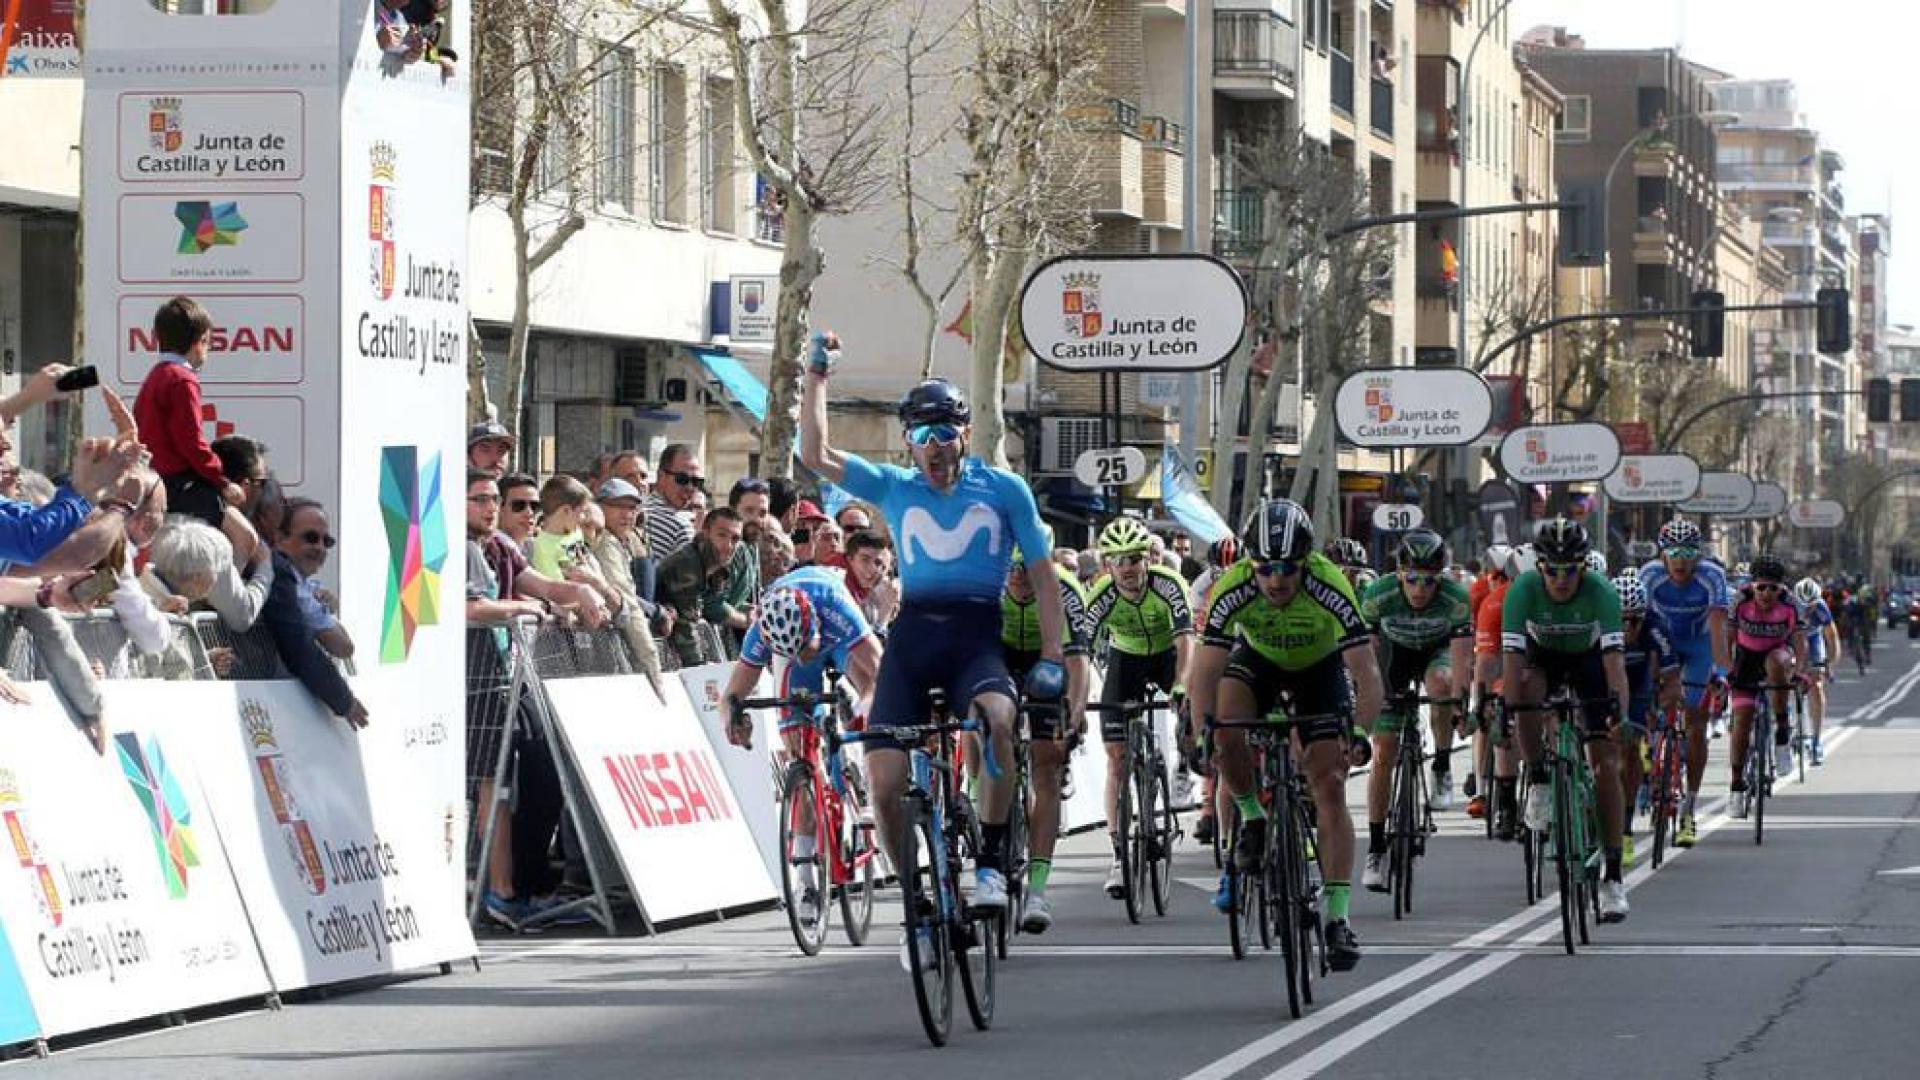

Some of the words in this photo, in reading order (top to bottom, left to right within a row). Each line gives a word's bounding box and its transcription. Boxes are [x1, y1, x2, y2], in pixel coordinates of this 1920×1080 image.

[193, 133, 253, 150] Junta
[258, 133, 286, 150] de
[137, 155, 211, 172] Castilla
[214, 159, 228, 177] y
[234, 154, 286, 172] León
[404, 252, 445, 301] Junta
[446, 259, 460, 304] de
[1108, 318, 1166, 336] Junta
[1171, 315, 1197, 333] de
[128, 327, 294, 352] NSAN
[358, 310, 416, 361] Castilla
[418, 328, 430, 376] y
[431, 317, 460, 365] León
[1051, 340, 1125, 359] Castilla
[1129, 342, 1143, 362] y
[1148, 337, 1198, 356] León
[1397, 408, 1438, 422] Junta
[1441, 408, 1461, 420] de
[1356, 423, 1409, 437] Castilla
[1411, 425, 1421, 439] y
[1096, 457, 1128, 484] 25
[1387, 511, 1411, 529] 50
[1304, 573, 1361, 628] MURIAS
[602, 749, 733, 830] NISSAN
[323, 839, 378, 885] Junta
[372, 831, 399, 877] de
[305, 903, 370, 956] Castilla
[371, 893, 421, 944] León
[361, 910, 382, 962] y
